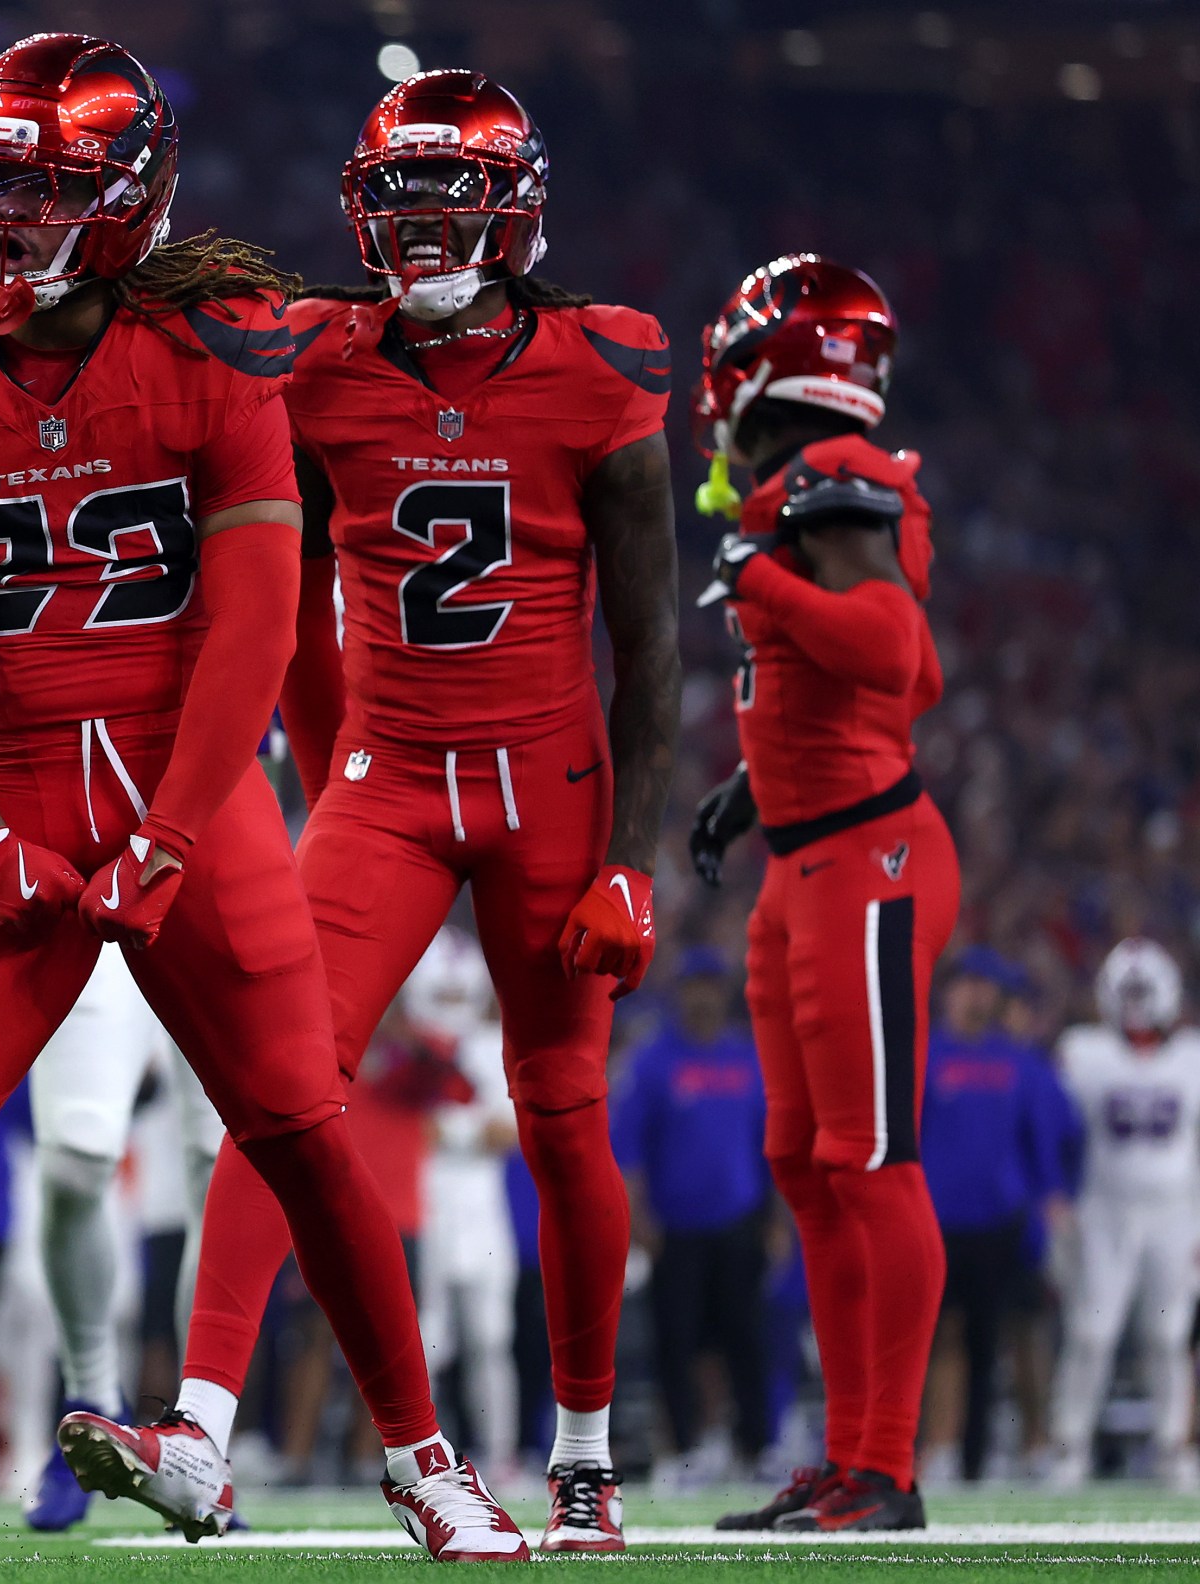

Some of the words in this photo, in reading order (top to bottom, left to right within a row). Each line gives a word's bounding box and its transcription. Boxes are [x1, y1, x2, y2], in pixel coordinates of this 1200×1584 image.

[70, 146, 104, 156] OAKLEY
[391, 457, 509, 472] TEXANS
[392, 479, 514, 650] 2
